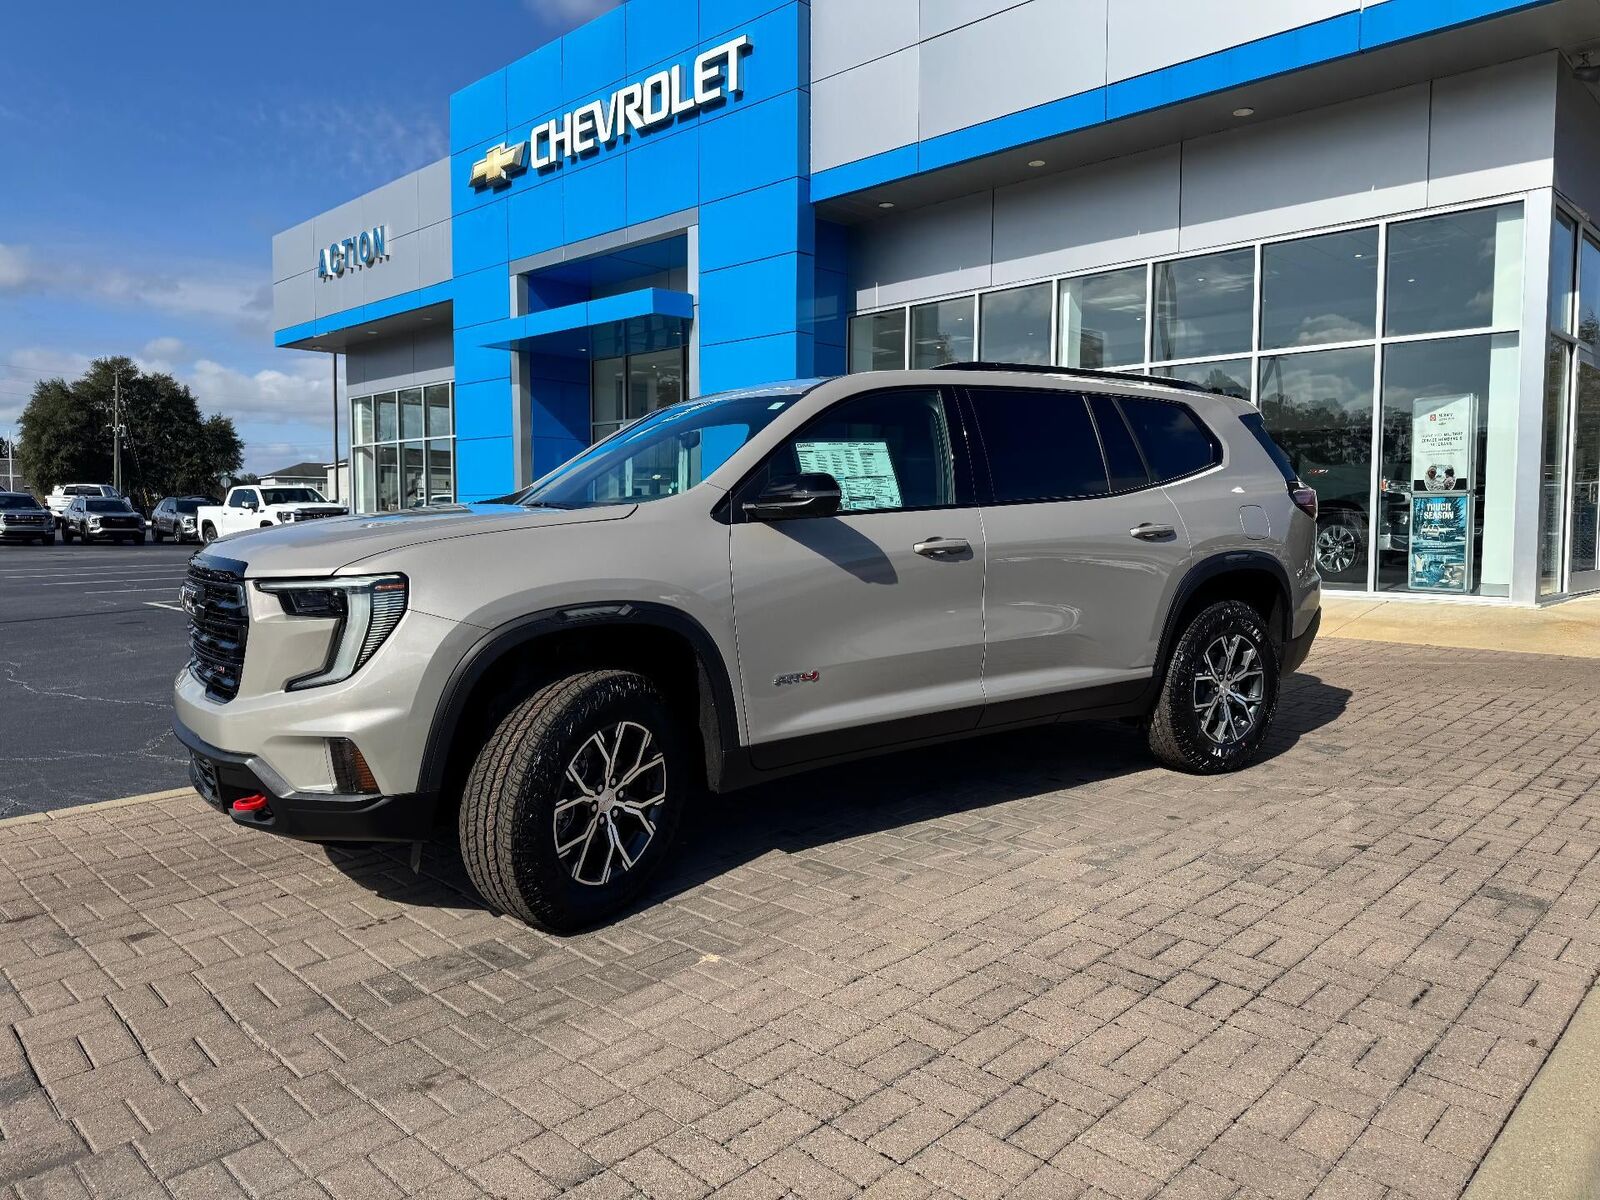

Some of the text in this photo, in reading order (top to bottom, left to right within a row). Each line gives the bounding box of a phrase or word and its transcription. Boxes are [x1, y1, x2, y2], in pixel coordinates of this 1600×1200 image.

[531, 33, 748, 170] CHEVROLET
[318, 224, 386, 279] ACTION
[1424, 511, 1454, 520] SEASON
[1426, 503, 1452, 511] TRUCK
